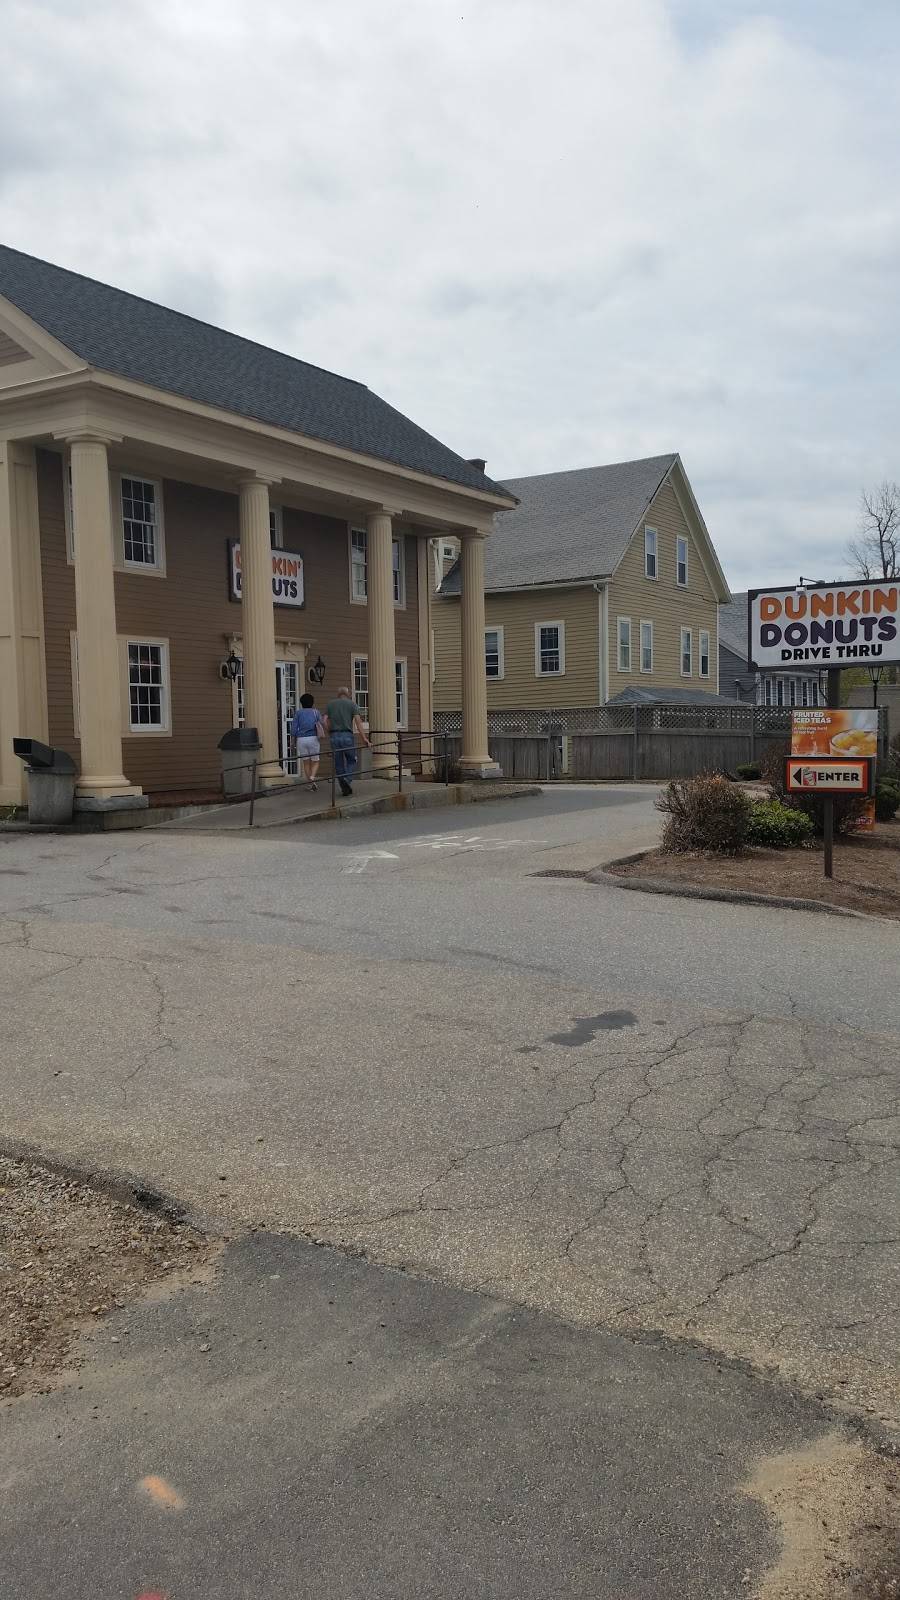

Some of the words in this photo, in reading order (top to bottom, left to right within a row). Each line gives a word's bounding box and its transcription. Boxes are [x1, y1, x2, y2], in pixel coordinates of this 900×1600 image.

[760, 616, 897, 647] DONUTS
[781, 647, 831, 660] DRIVE
[836, 644, 883, 657] THRU
[817, 772, 859, 782] ENTER
